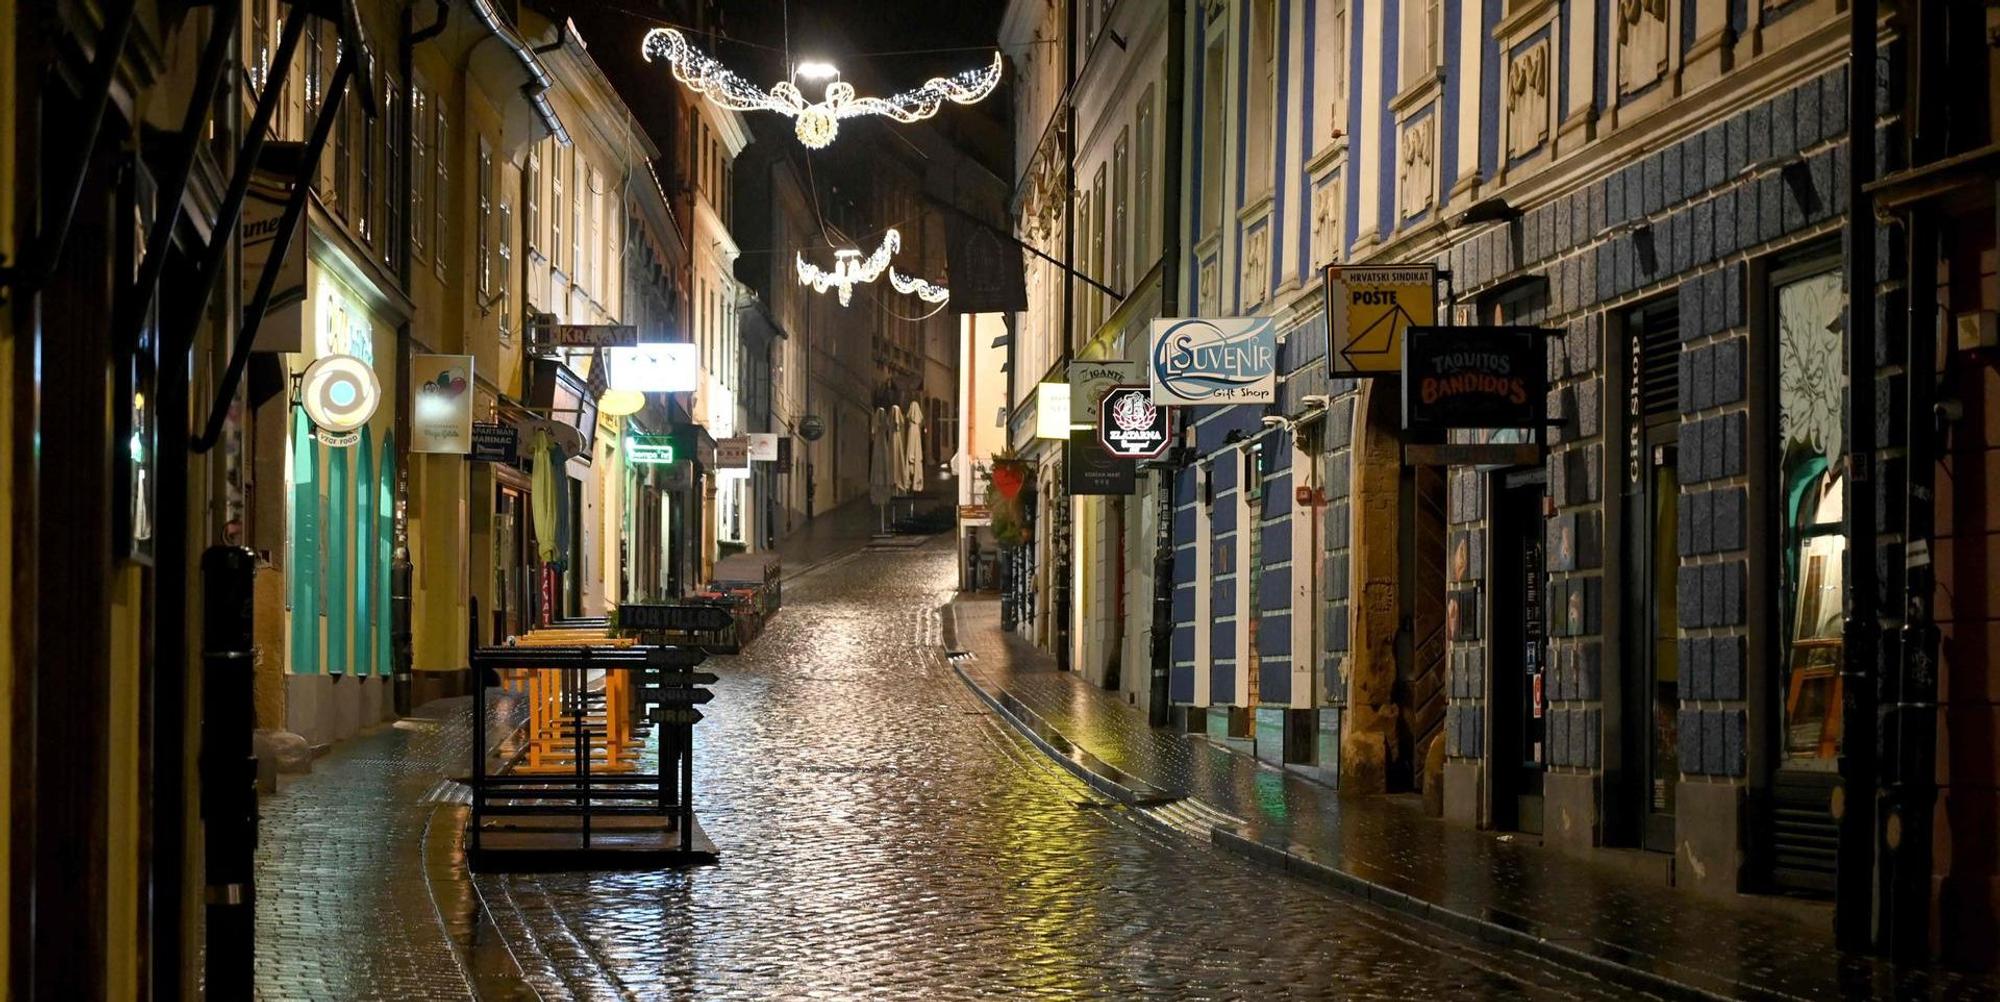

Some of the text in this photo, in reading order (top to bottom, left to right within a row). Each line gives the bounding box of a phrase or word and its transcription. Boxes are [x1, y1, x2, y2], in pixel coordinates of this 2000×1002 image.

[1350, 271, 1429, 281] HRVATSKI SINDIKAT
[1352, 286, 1397, 305] POŠTE
[1431, 352, 1511, 374] TAQUITOS
[1630, 336, 1640, 416] Shop
[1213, 387, 1270, 400] Gift Shop
[1422, 372, 1526, 404] BANDIDOS
[1109, 430, 1162, 440] ZLATARNA
